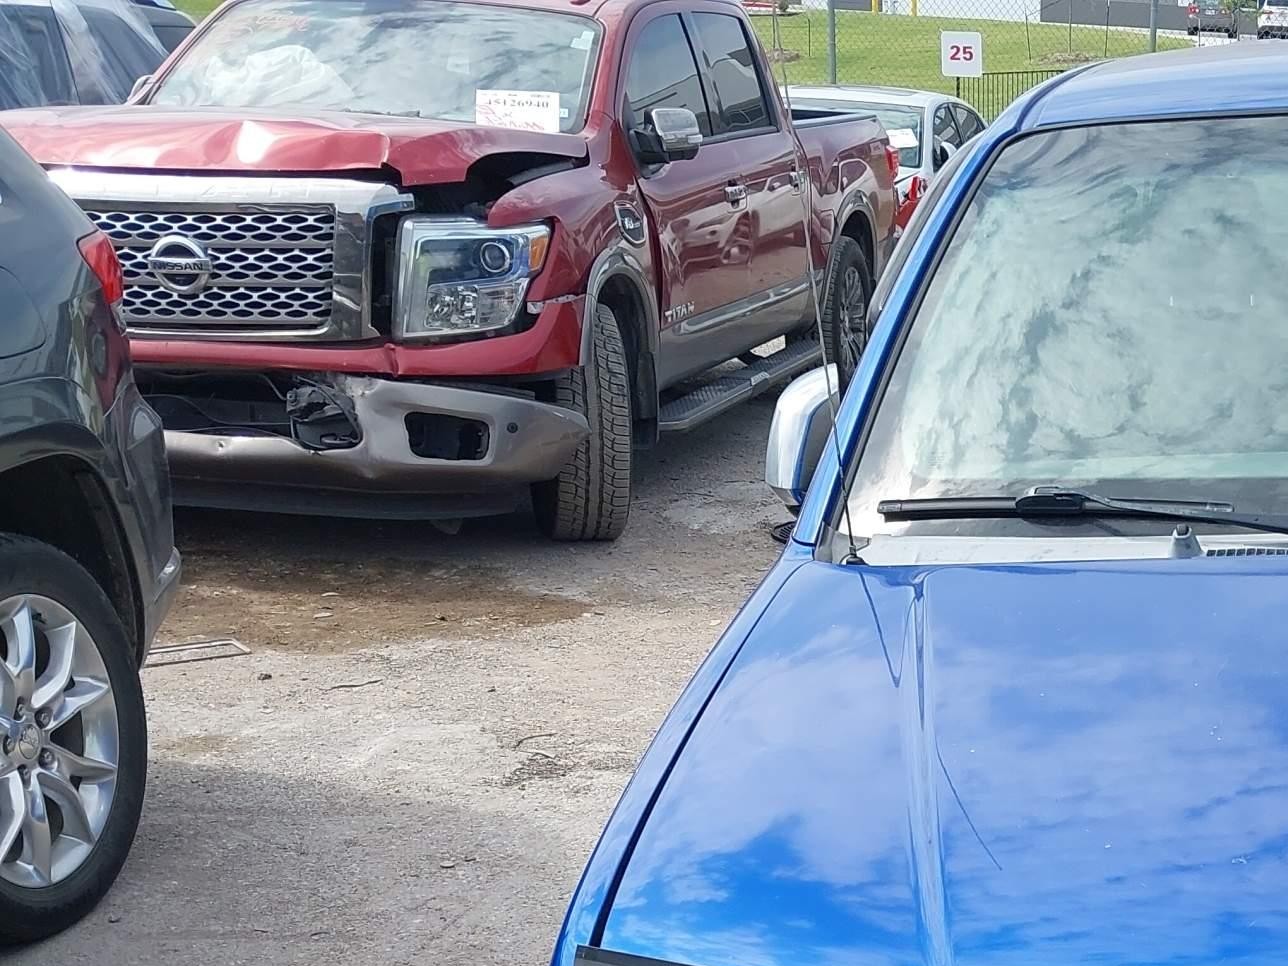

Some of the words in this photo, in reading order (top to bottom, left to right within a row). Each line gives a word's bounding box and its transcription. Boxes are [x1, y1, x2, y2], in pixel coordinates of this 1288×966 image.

[950, 45, 974, 61] 25
[152, 262, 204, 272] NISSAN
[665, 302, 695, 322] TITAN
